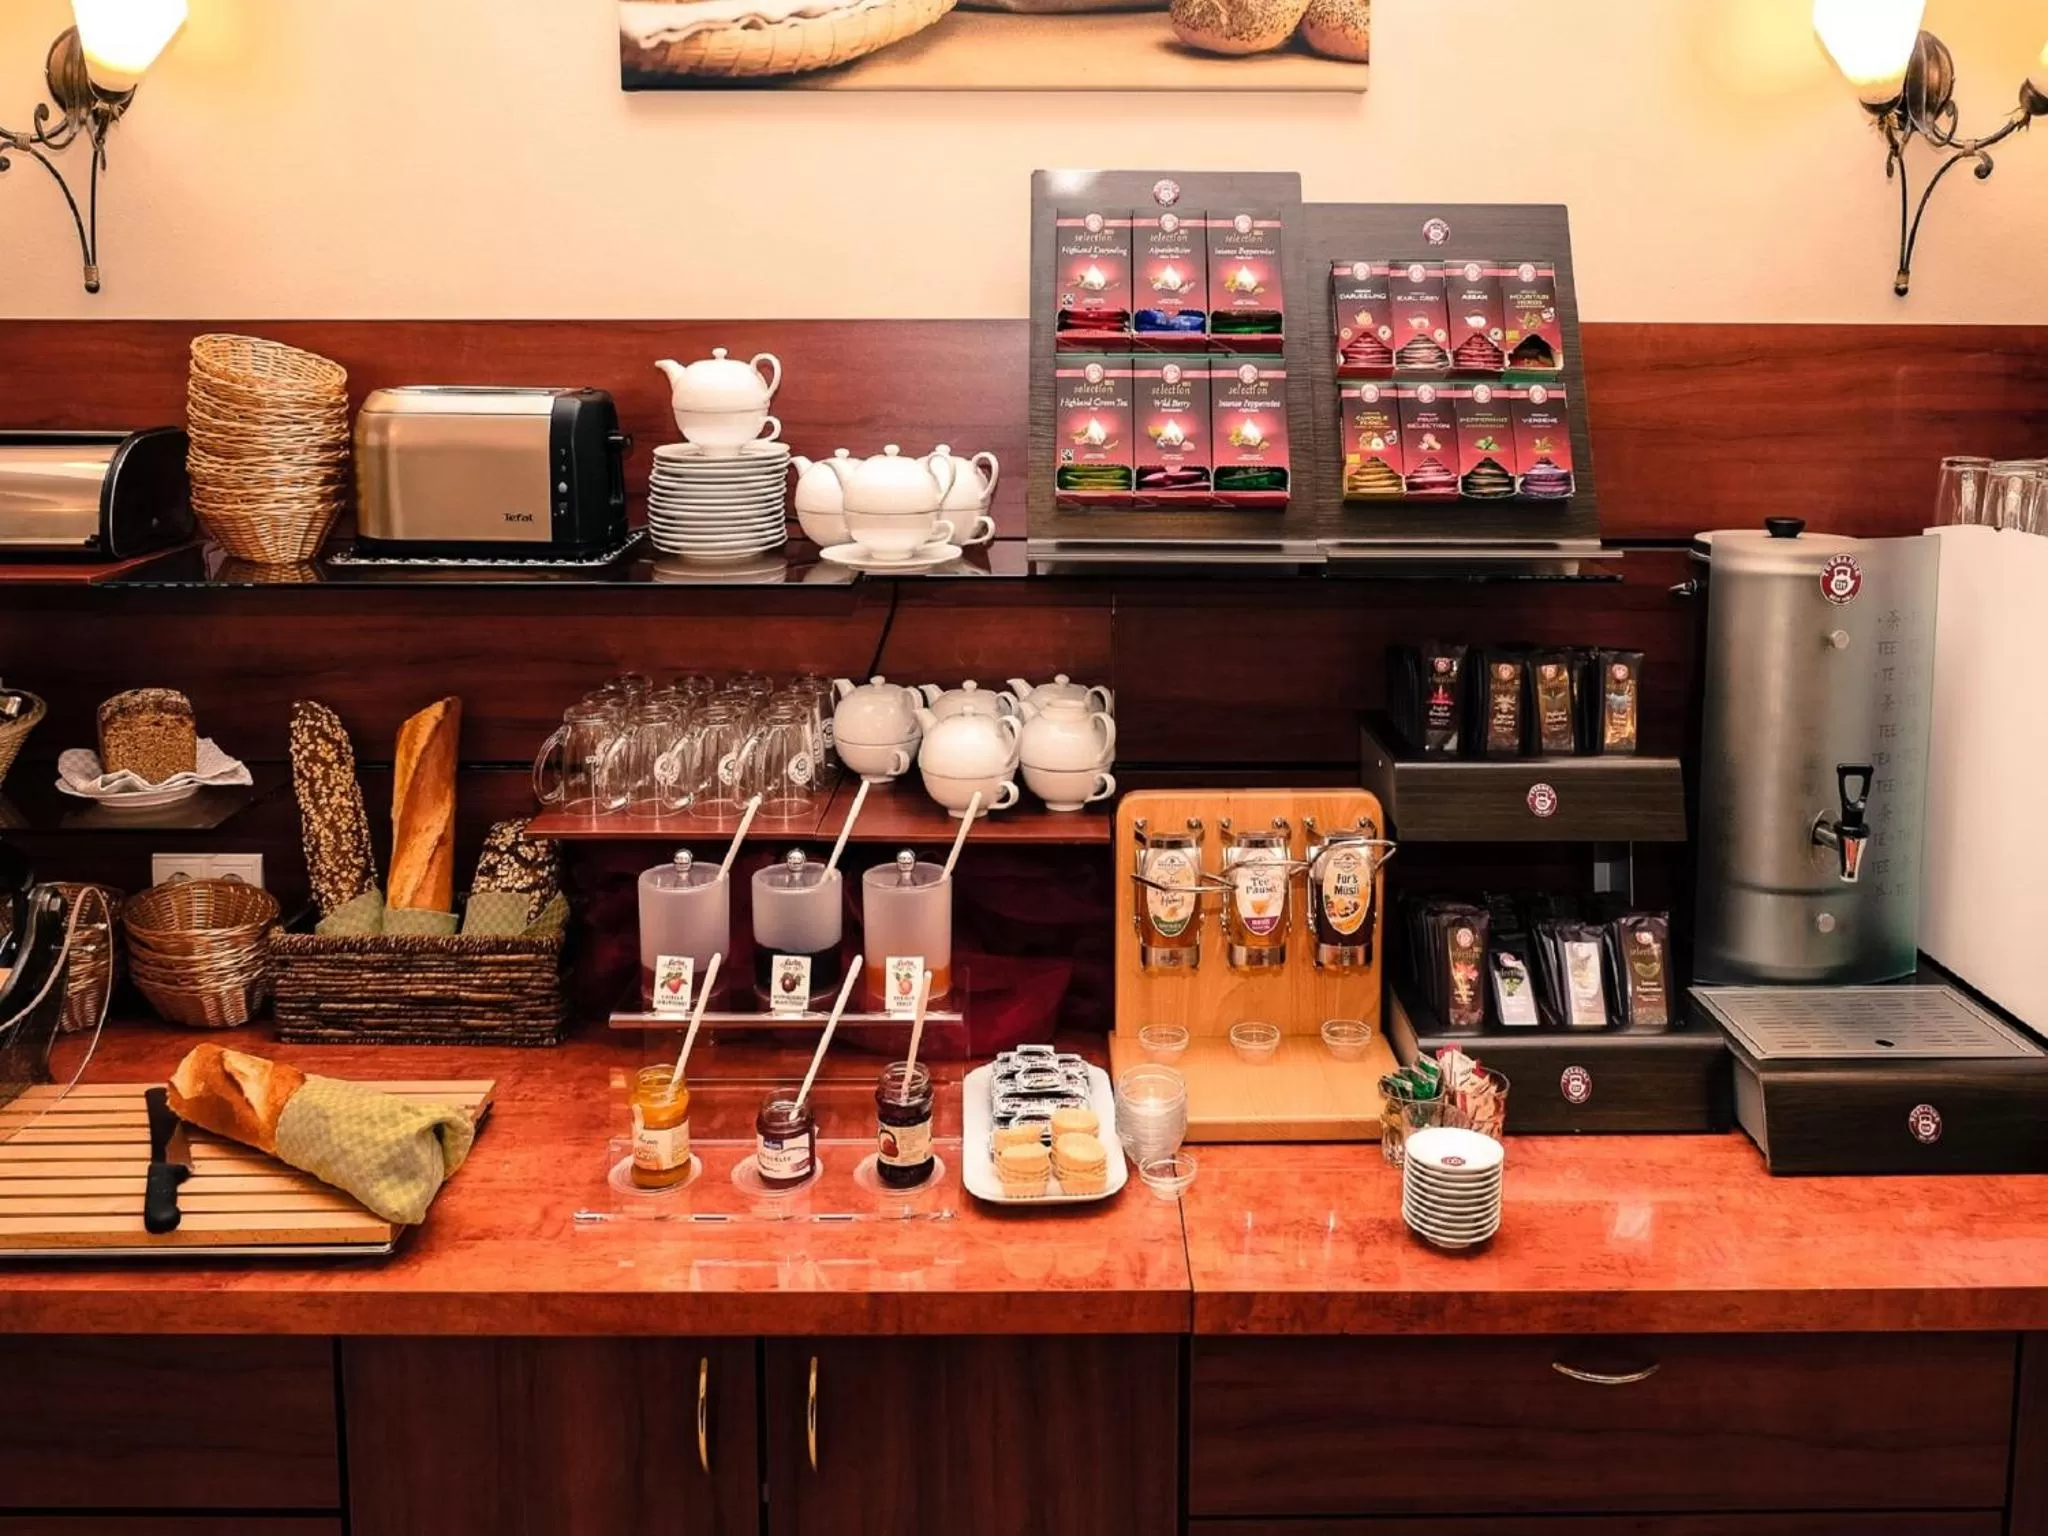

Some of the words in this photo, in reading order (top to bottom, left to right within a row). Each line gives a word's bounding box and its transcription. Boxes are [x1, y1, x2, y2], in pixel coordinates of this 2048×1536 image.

[1073, 383, 1114, 395] selection
[1151, 383, 1191, 396] selection
[1227, 383, 1269, 396] selection
[503, 511, 534, 522] Tefal
[1250, 877, 1268, 887] Tee
